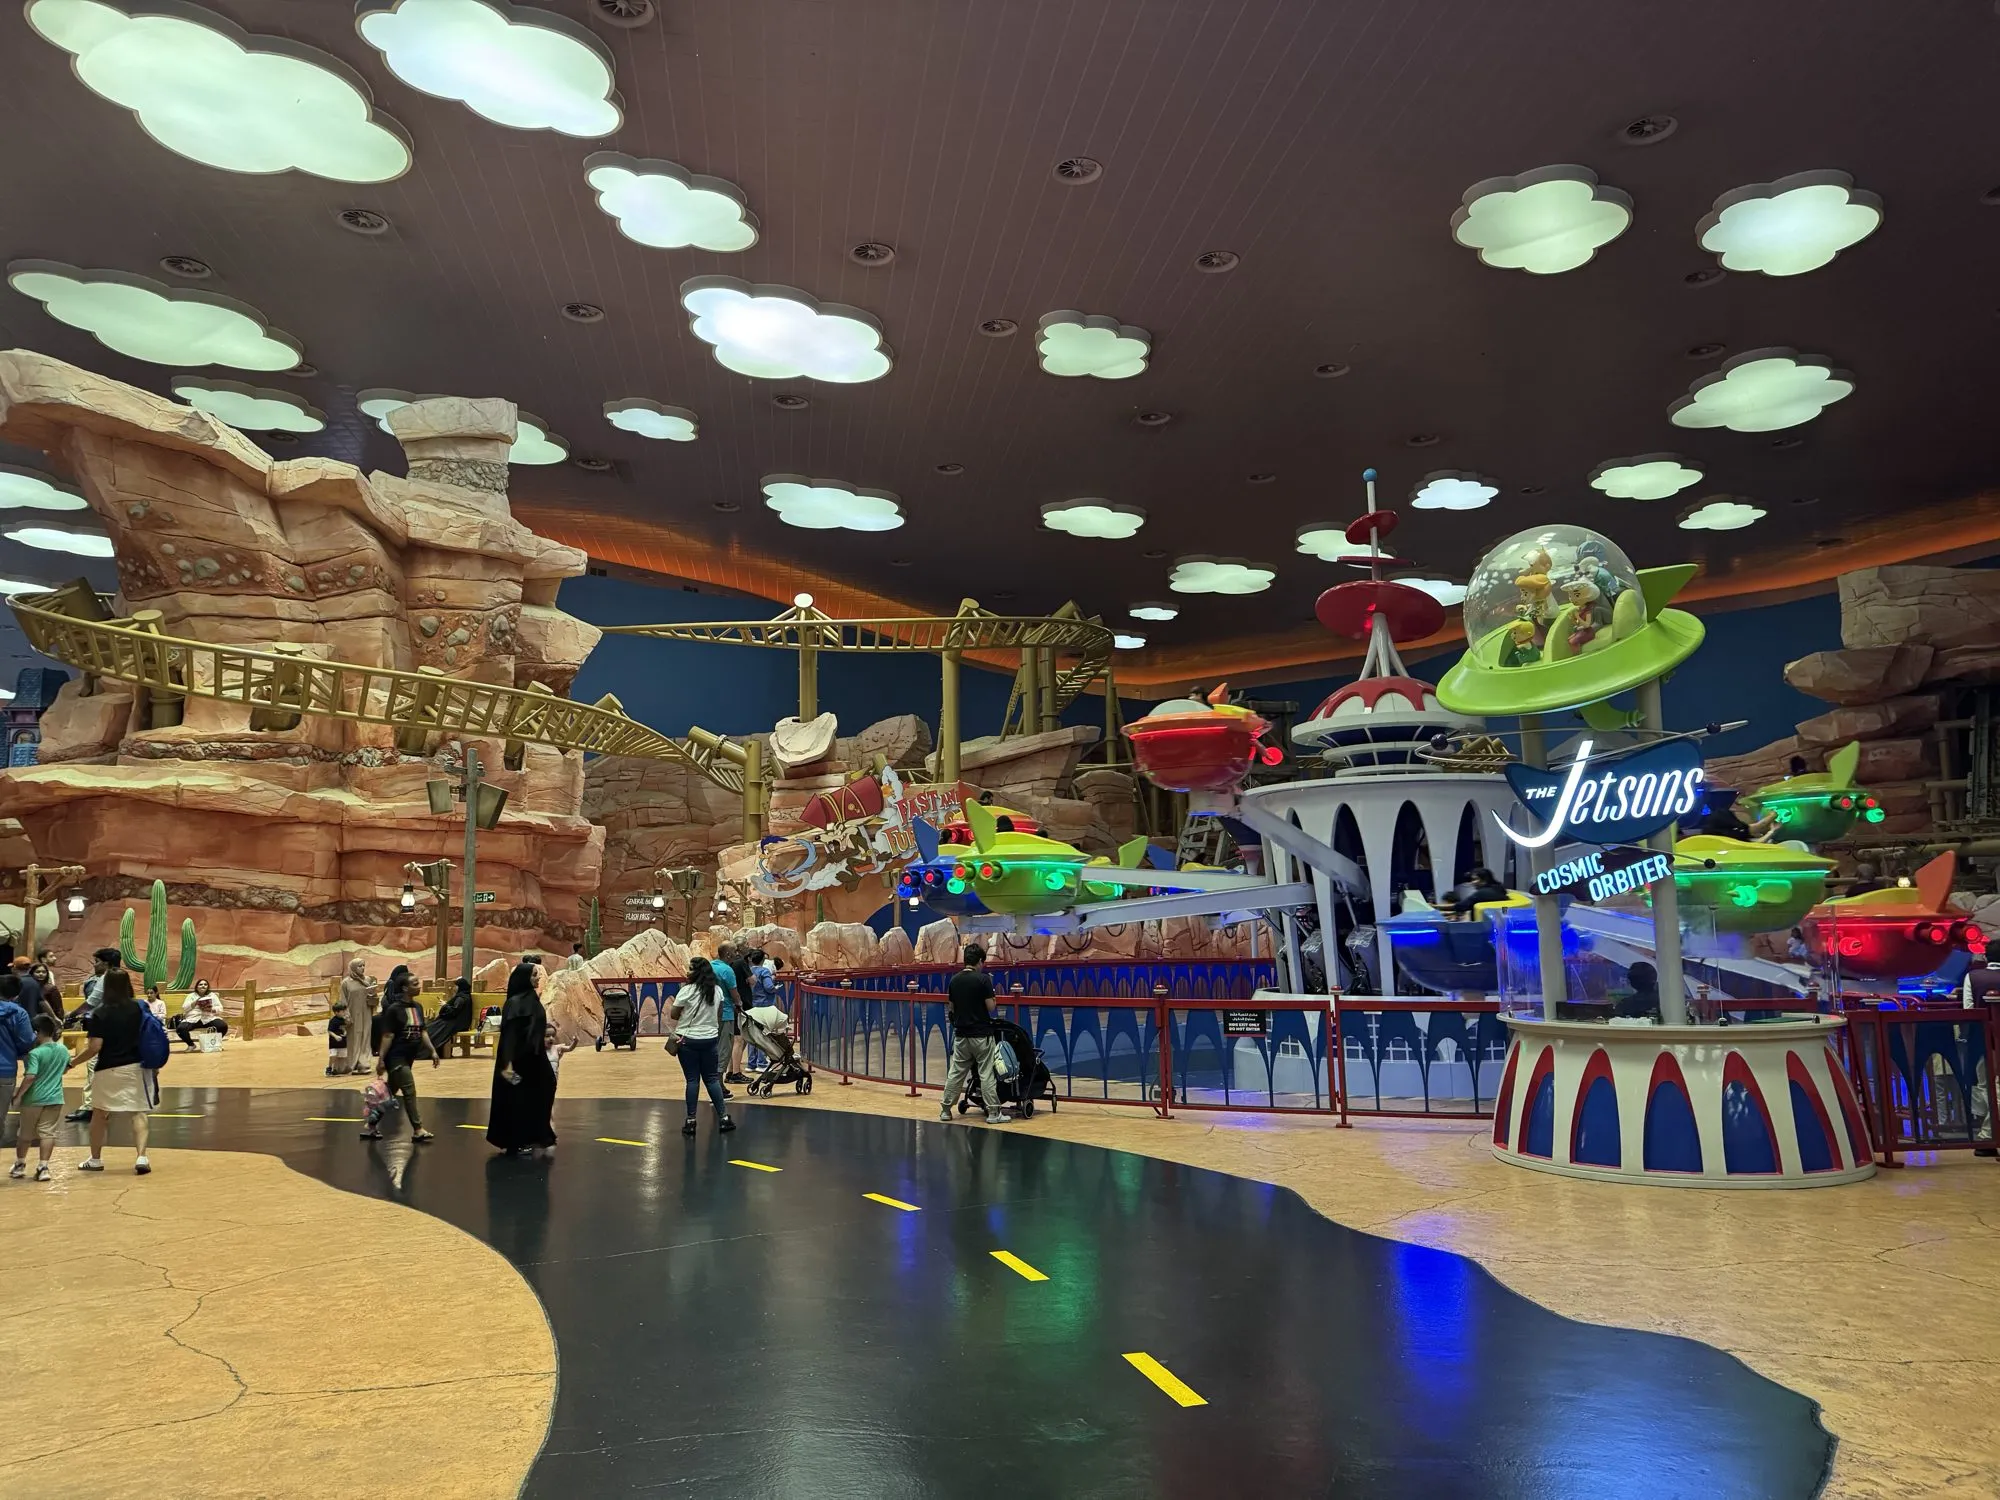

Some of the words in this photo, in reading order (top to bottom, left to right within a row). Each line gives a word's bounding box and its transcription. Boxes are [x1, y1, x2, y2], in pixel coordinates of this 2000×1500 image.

[892, 790, 938, 827] FAST
[1491, 740, 1704, 848] Jetsons
[1525, 786, 1557, 800] THE
[1536, 852, 1605, 895] COSMIC
[1588, 854, 1672, 903] ORBITER
